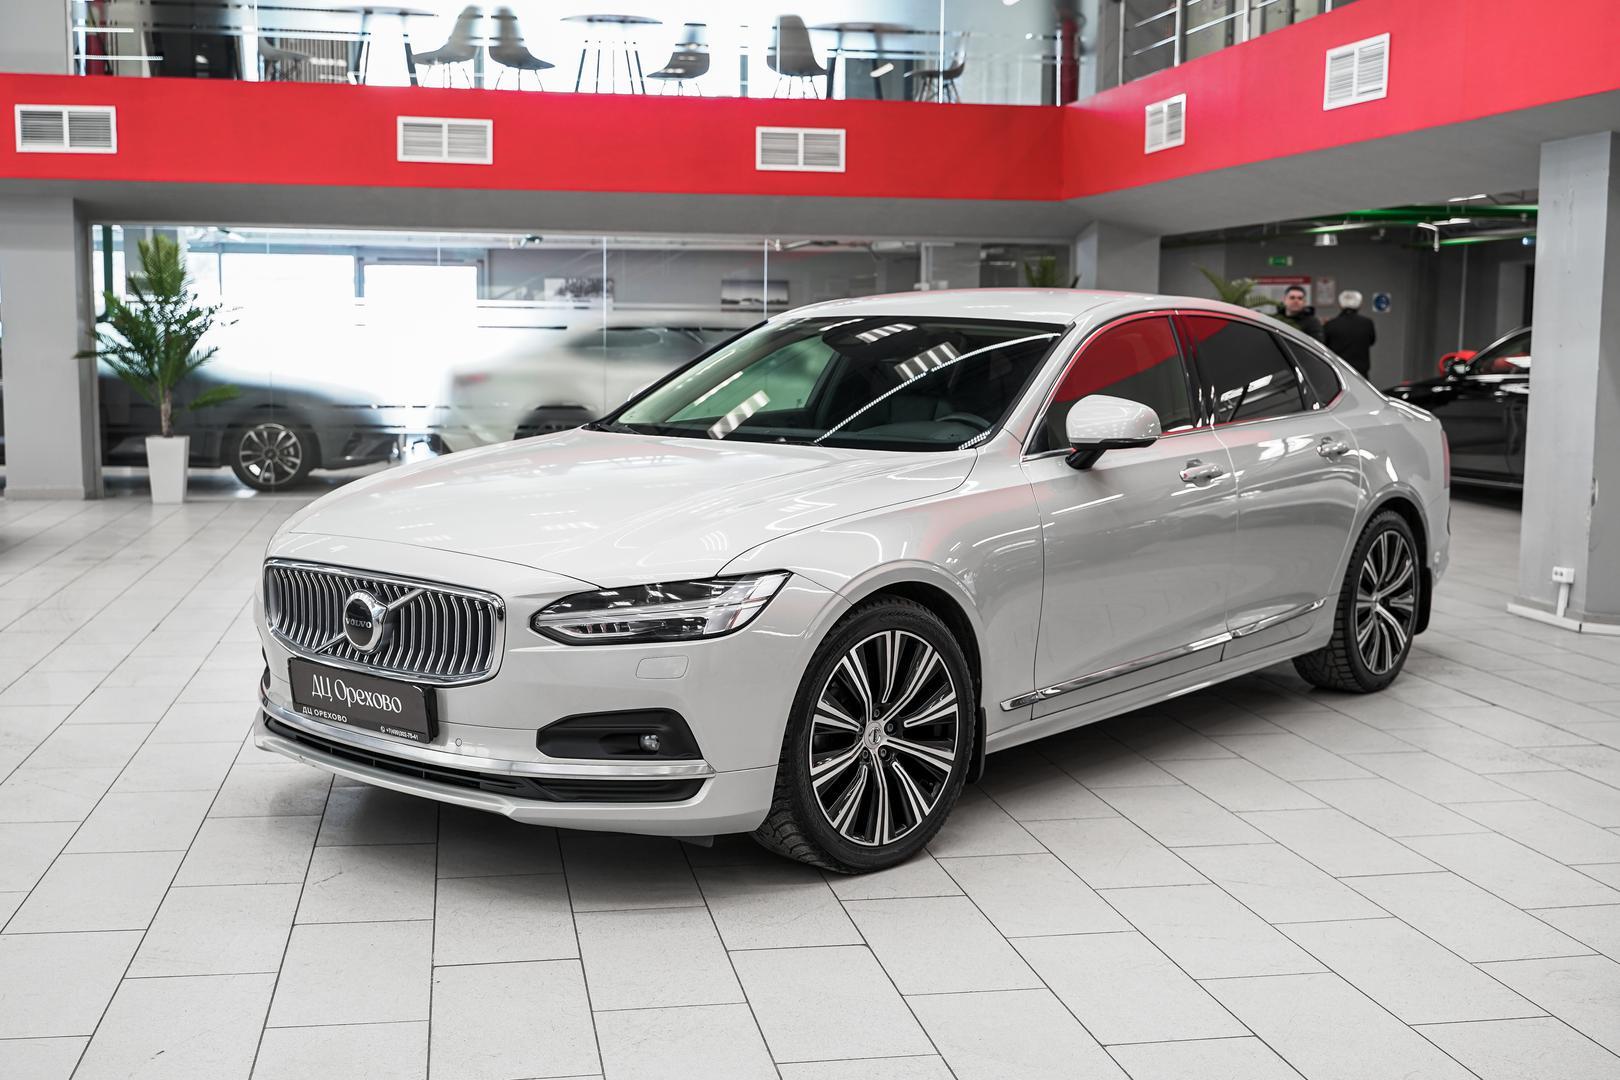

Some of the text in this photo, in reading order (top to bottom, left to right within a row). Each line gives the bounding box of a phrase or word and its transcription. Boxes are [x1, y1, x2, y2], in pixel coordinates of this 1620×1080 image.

[345, 618, 372, 629] VOLVO
[312, 674, 402, 714] ДЦ Орехово
[302, 706, 348, 723] ДЦ ОРЕХОВО
